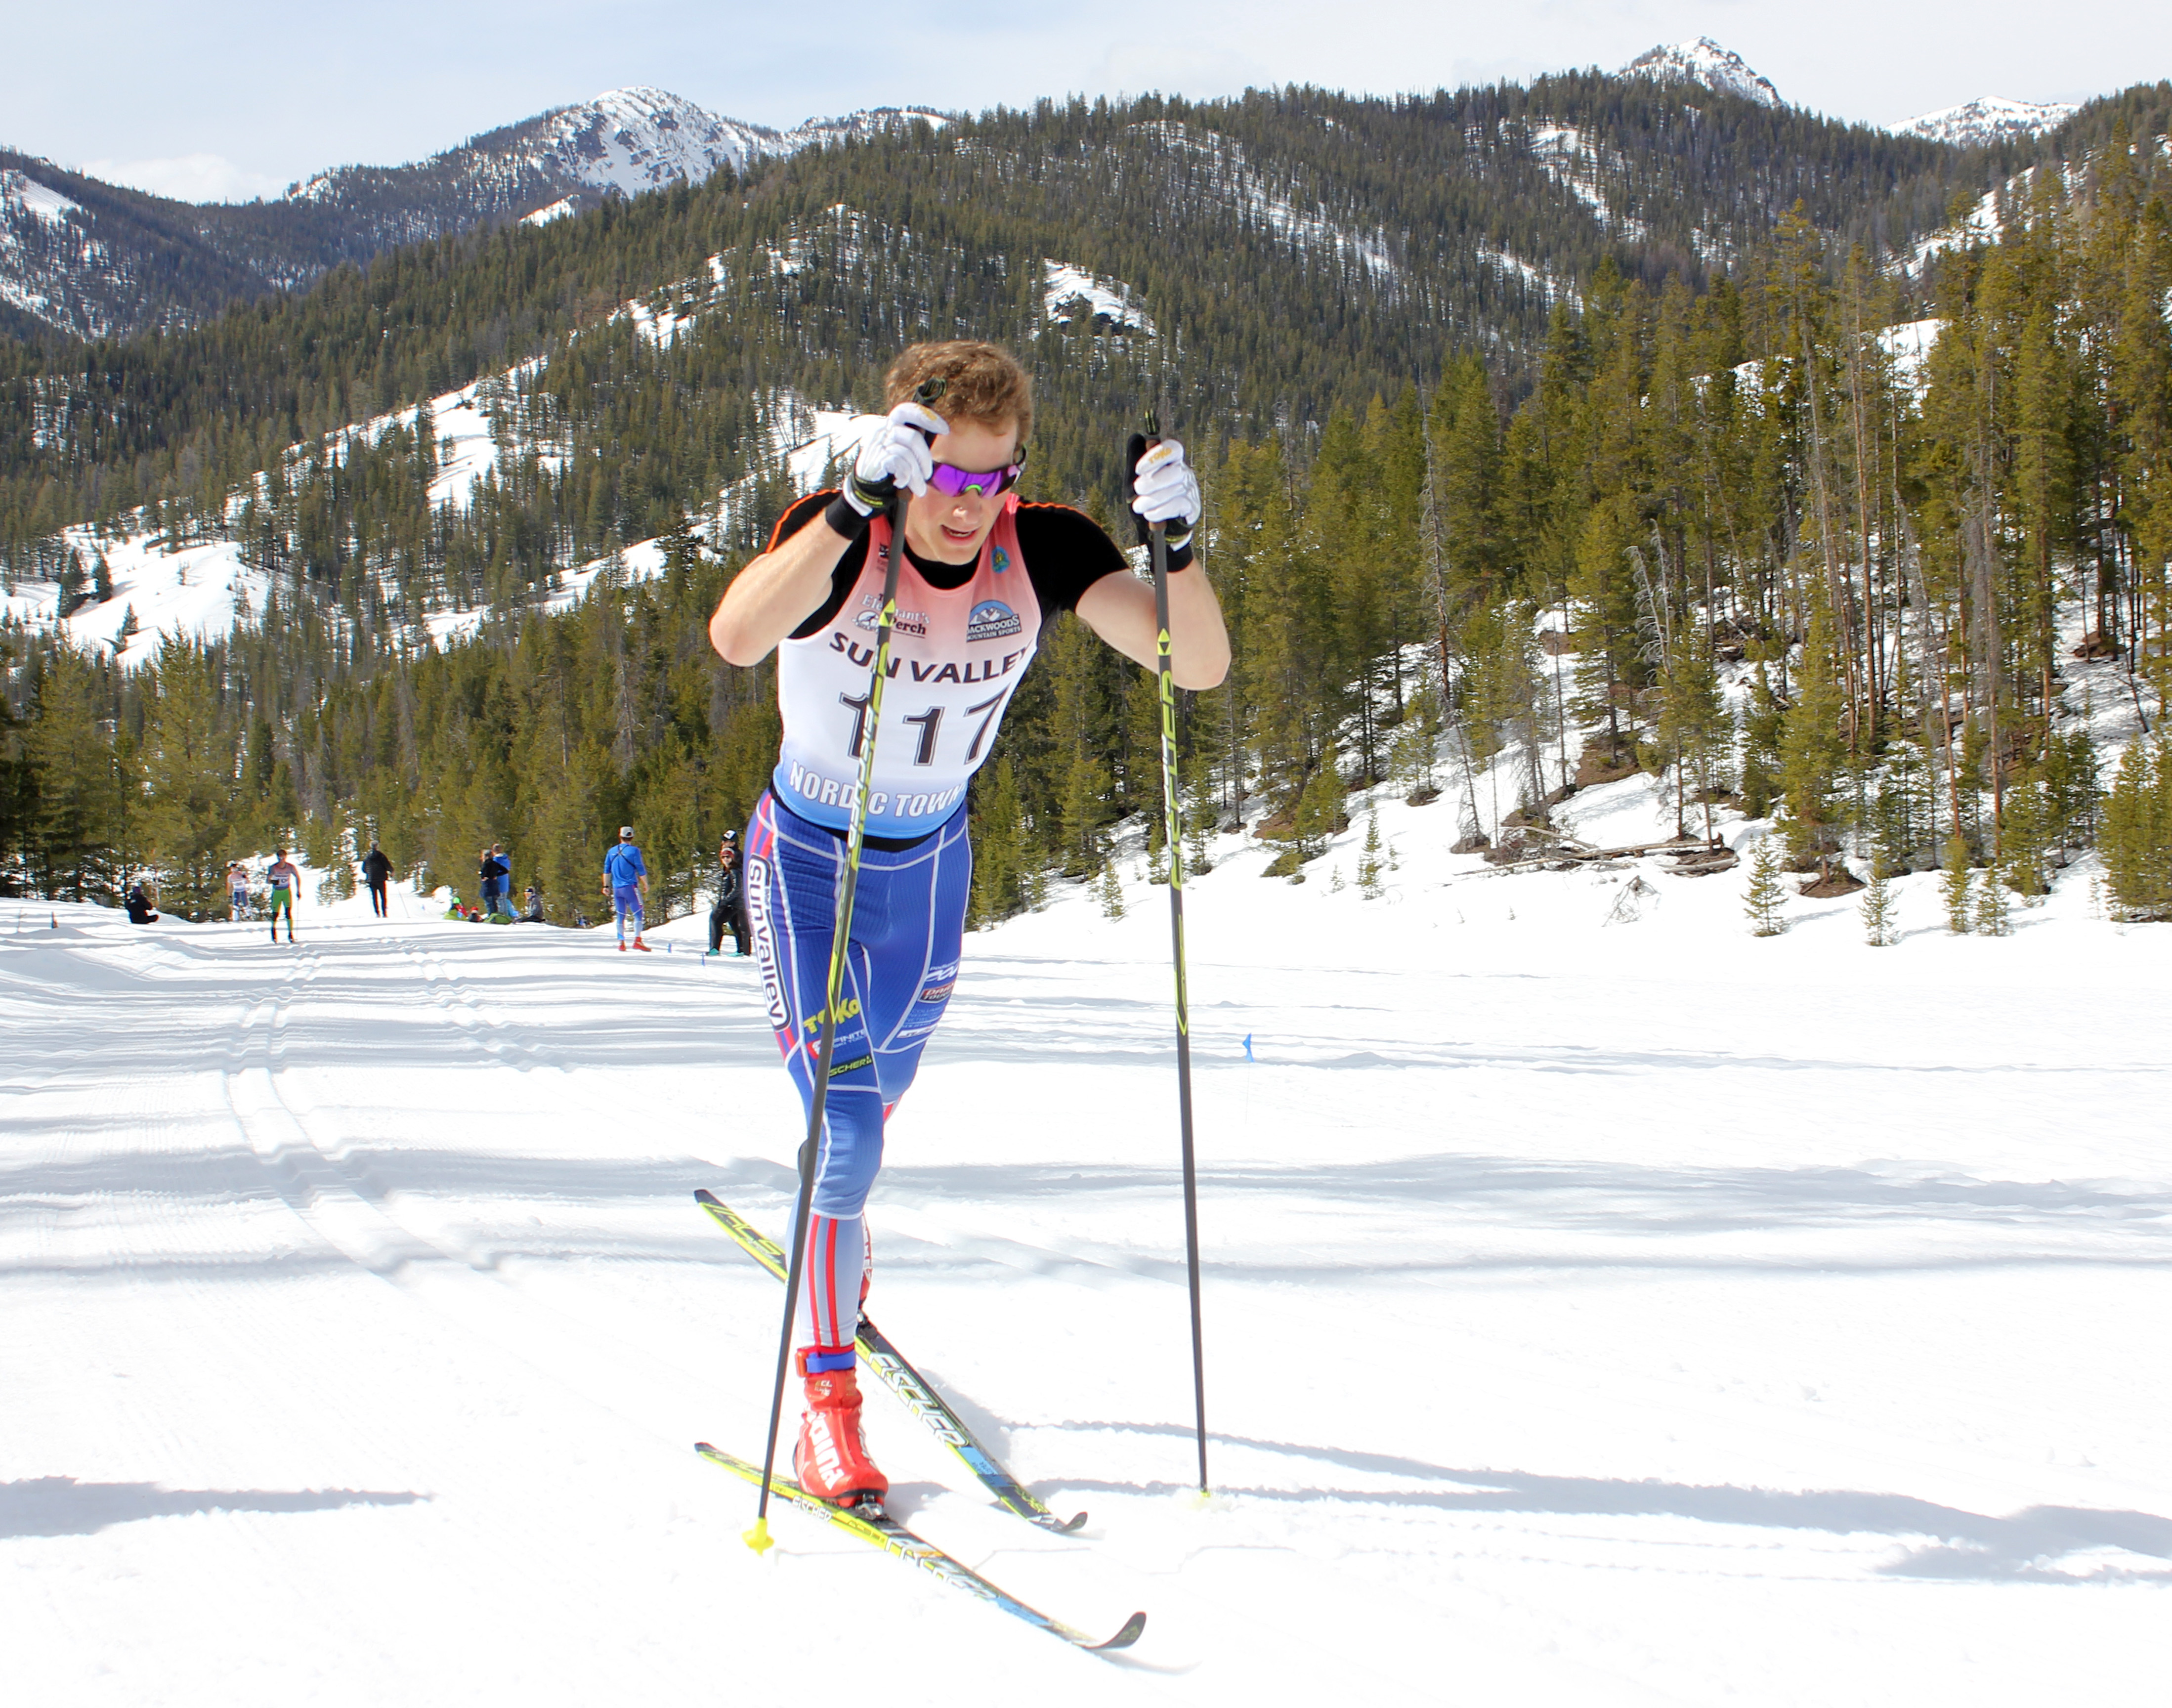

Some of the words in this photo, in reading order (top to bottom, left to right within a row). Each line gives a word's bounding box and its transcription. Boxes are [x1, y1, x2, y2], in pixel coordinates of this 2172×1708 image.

[862, 595, 930, 624] Eleant's
[911, 638, 1033, 683] VALLEY
[839, 683, 1012, 766] 117
[790, 761, 889, 815] NORDC
[829, 1058, 866, 1077] SCHER
[867, 1352, 969, 1447] FISCHER
[805, 1412, 845, 1491] pina
[792, 1495, 833, 1523] FISCHER
